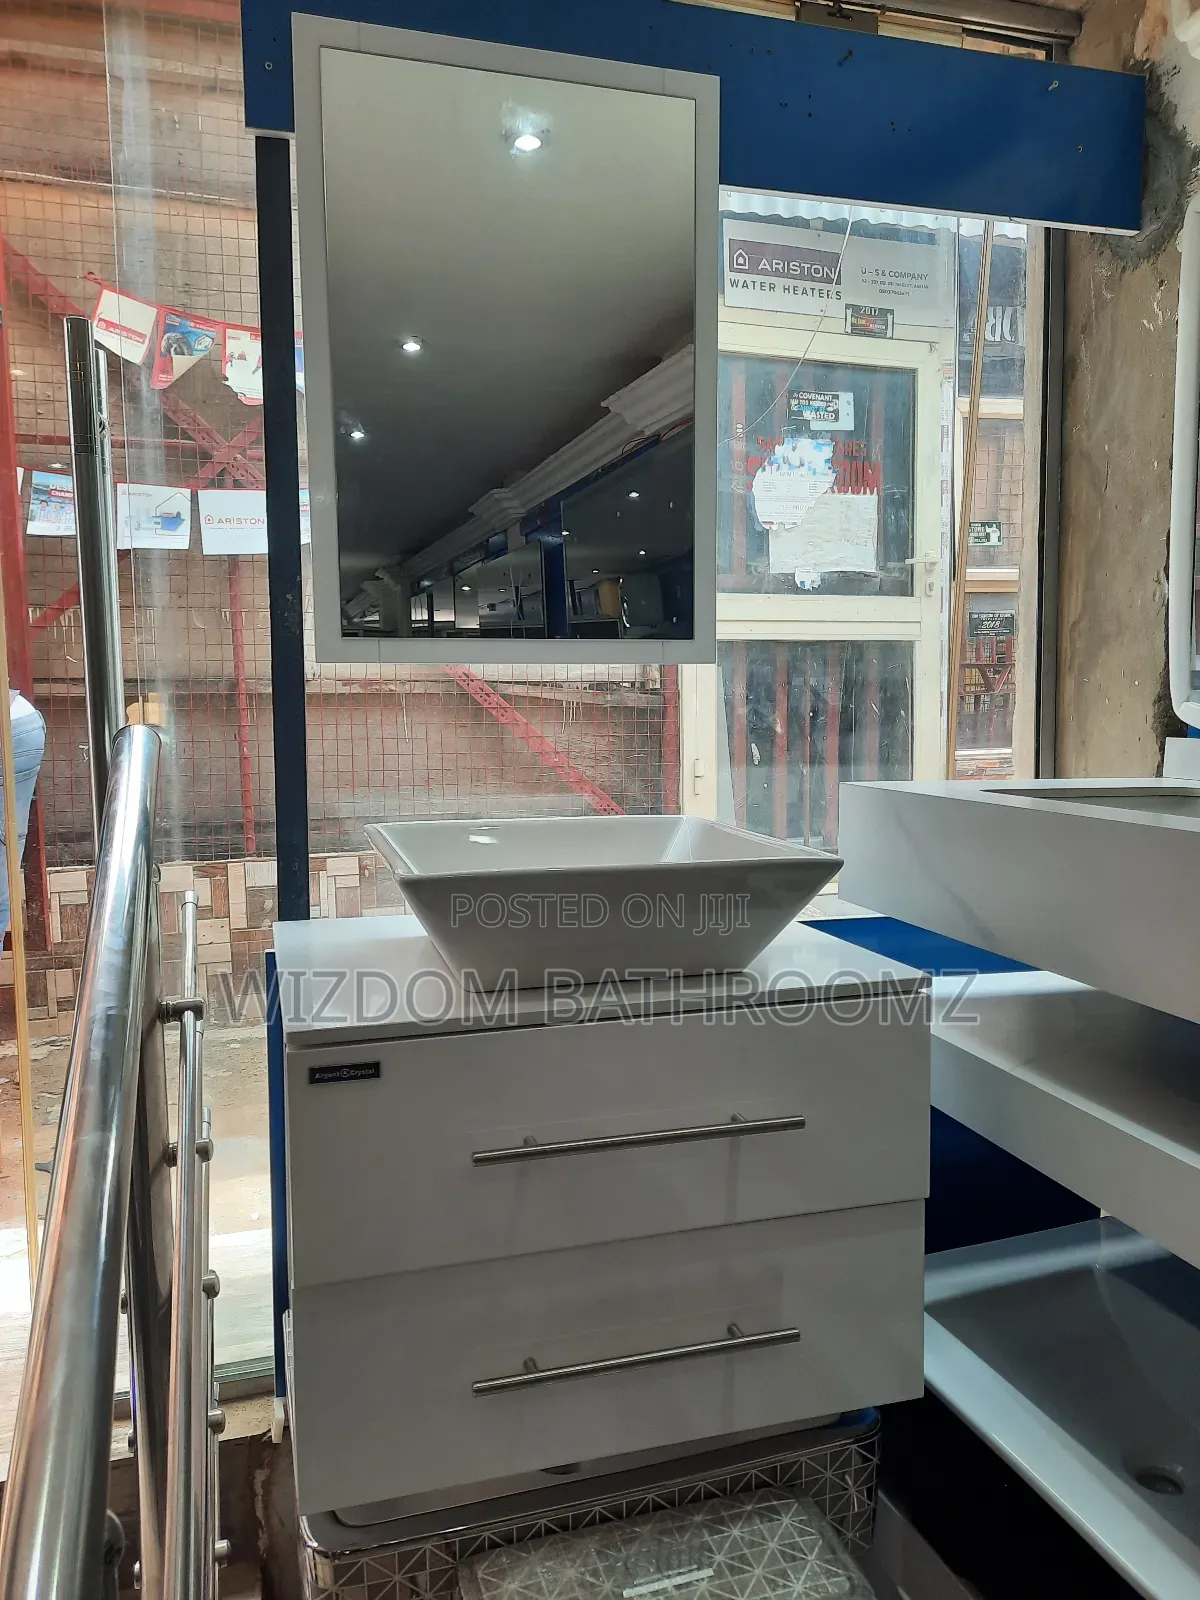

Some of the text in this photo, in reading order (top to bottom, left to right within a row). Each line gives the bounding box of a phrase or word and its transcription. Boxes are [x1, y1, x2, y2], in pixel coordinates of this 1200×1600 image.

[757, 258, 835, 280] ARISTON
[888, 270, 929, 281] COMPANY
[729, 278, 842, 300] WATER HEATERS
[860, 306, 879, 316] 2017
[798, 392, 833, 402] COVENANT
[802, 411, 835, 420] WASTED
[982, 620, 1000, 629] 2018
[350, 1067, 375, 1077] Crystal
